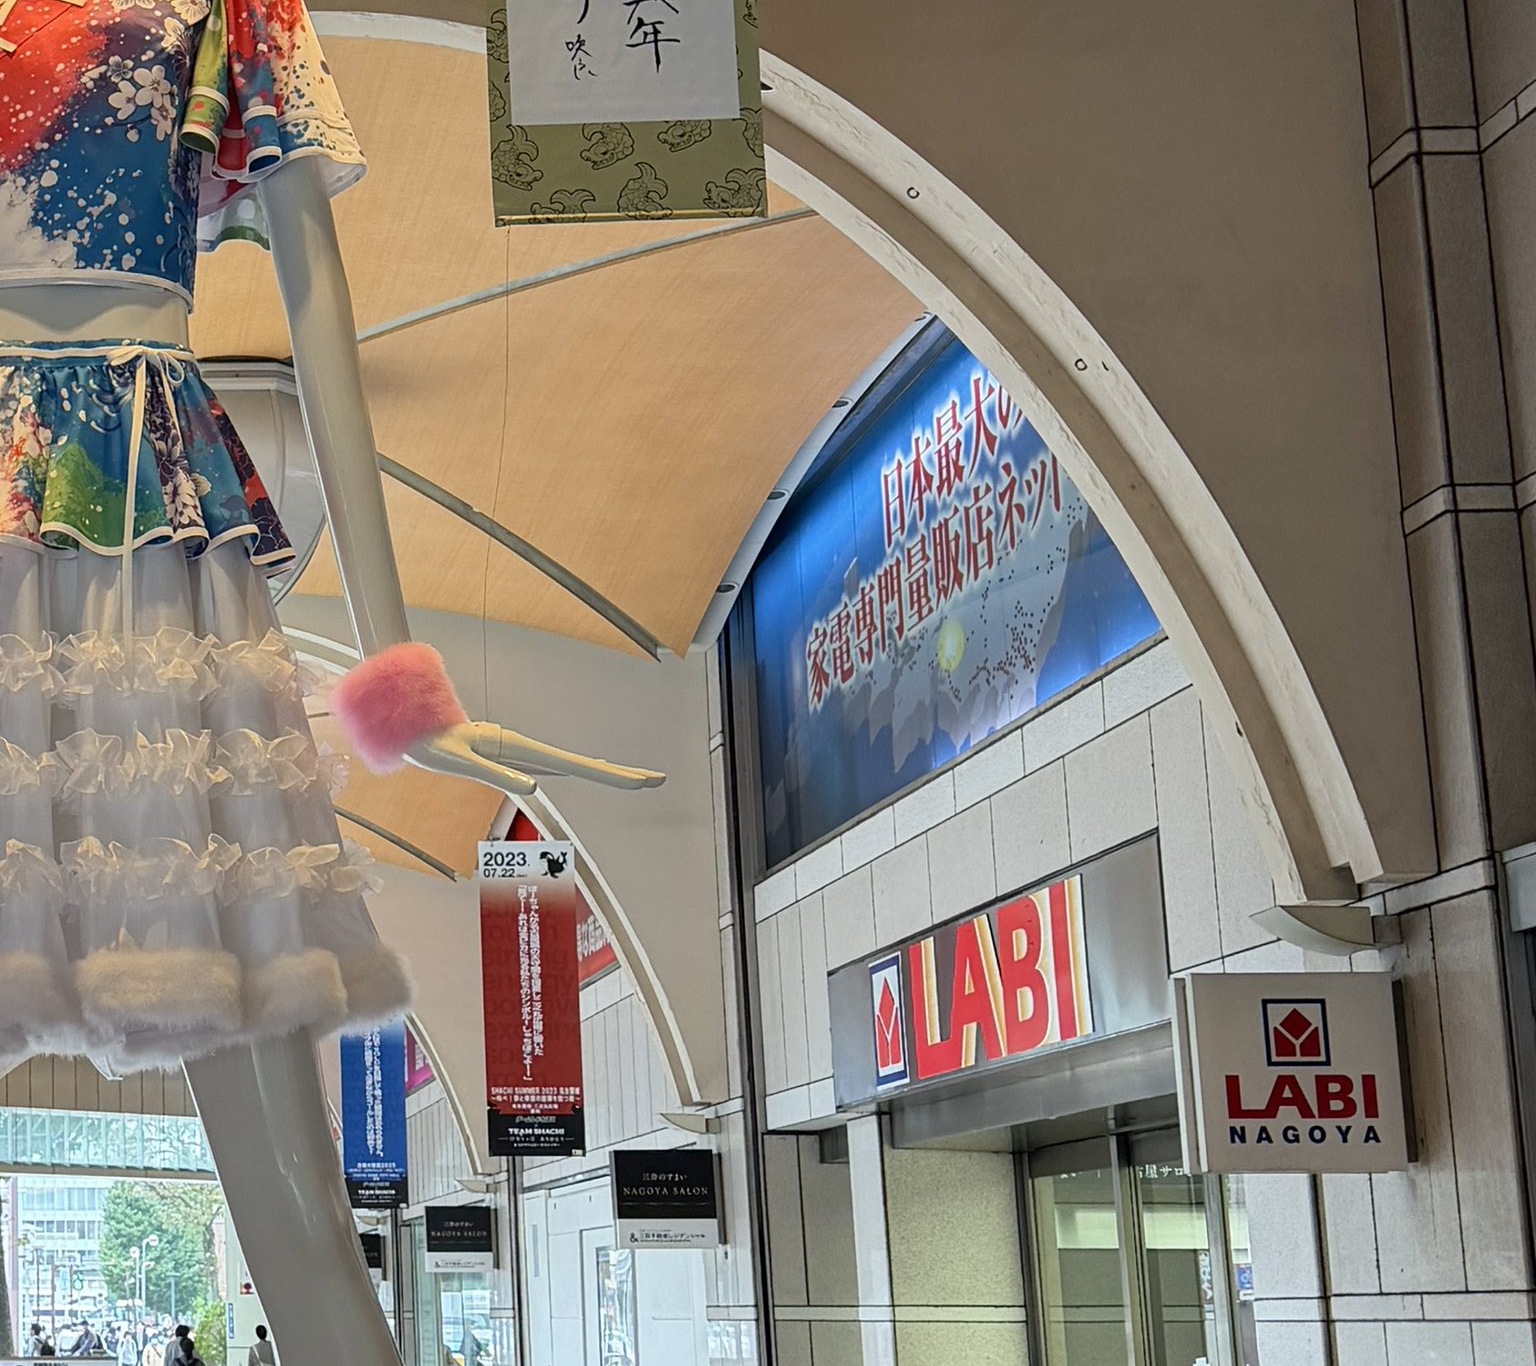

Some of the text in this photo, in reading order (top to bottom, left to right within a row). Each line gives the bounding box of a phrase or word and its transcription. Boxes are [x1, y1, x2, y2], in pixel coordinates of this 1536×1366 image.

[910, 875, 1093, 1079] LABI
[1225, 1074, 1379, 1119] LABI
[1229, 1124, 1381, 1145] NAGOYA
[623, 1186, 709, 1196] NAGOYA SALON
